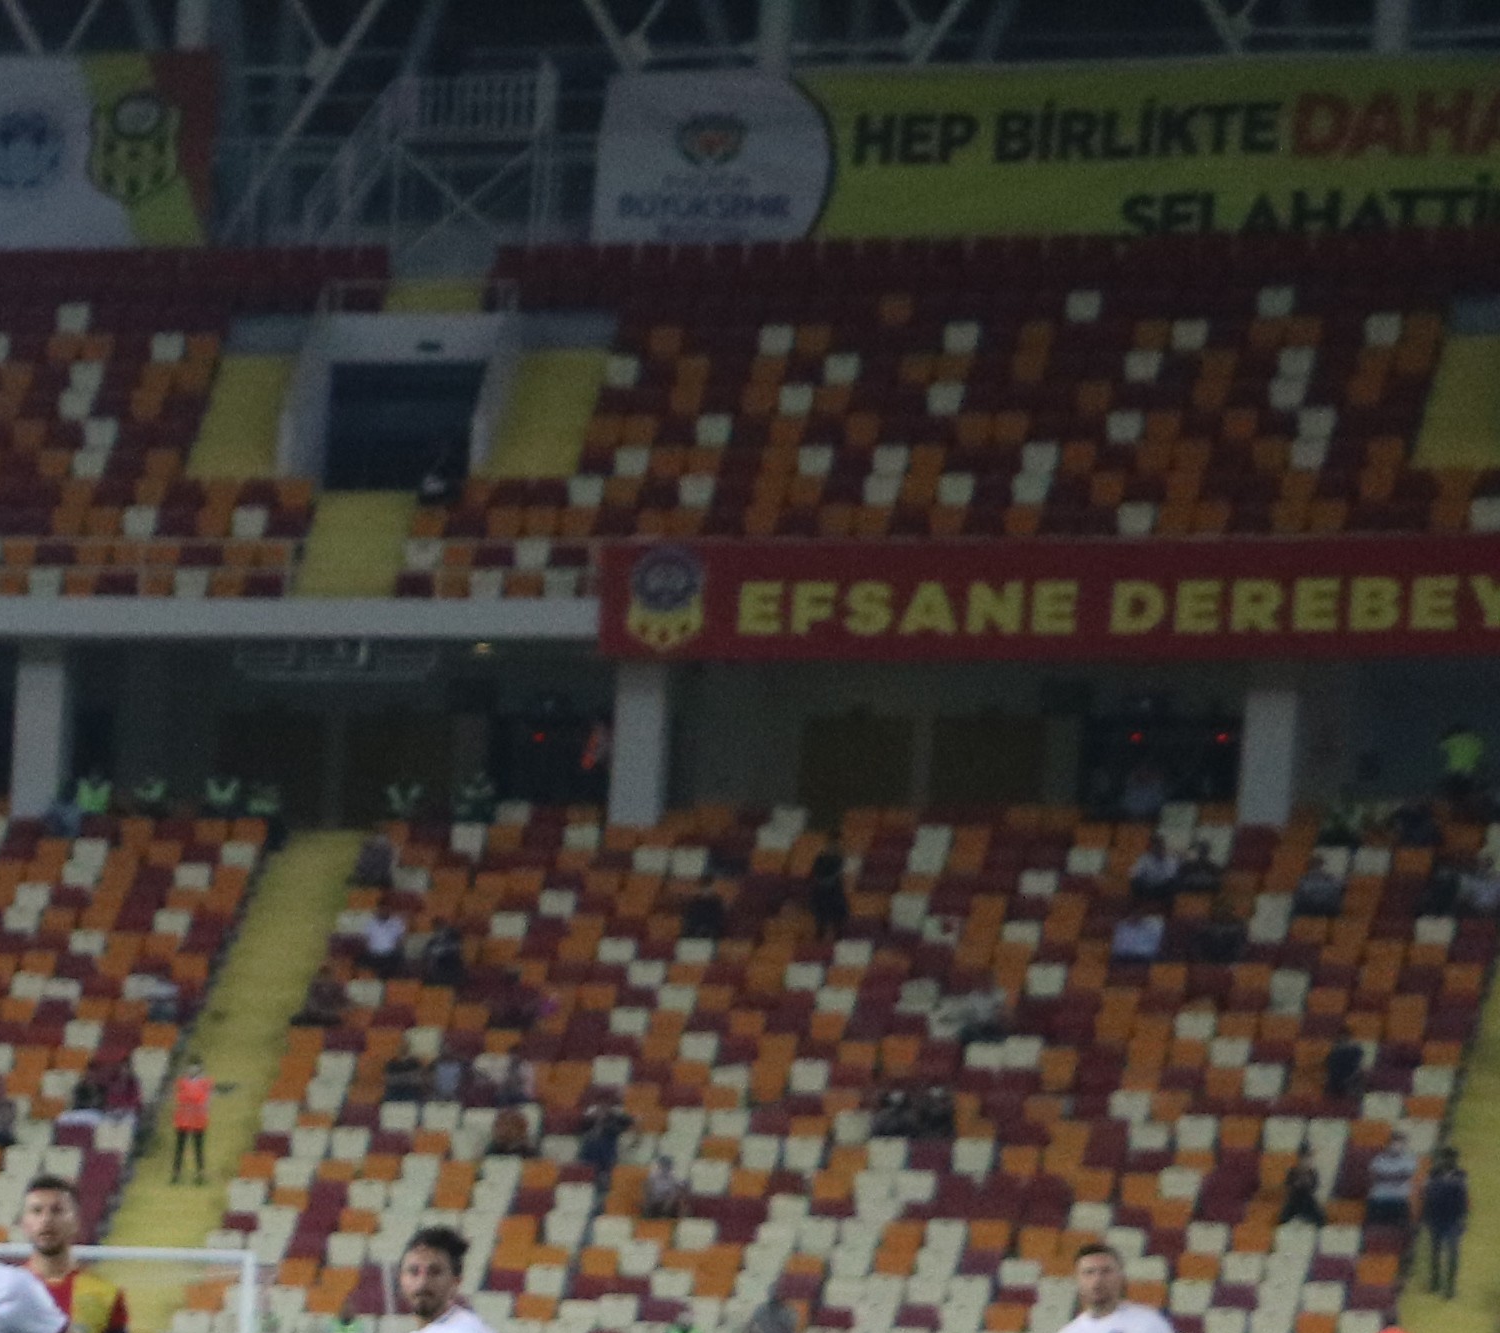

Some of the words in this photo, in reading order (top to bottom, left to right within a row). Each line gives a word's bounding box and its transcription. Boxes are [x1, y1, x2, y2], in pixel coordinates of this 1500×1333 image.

[854, 110, 980, 166] HEP
[994, 98, 1281, 163] BİRLİKTE
[1122, 173, 1500, 238] SELAHATTİ
[735, 578, 1080, 637] EFSANE
